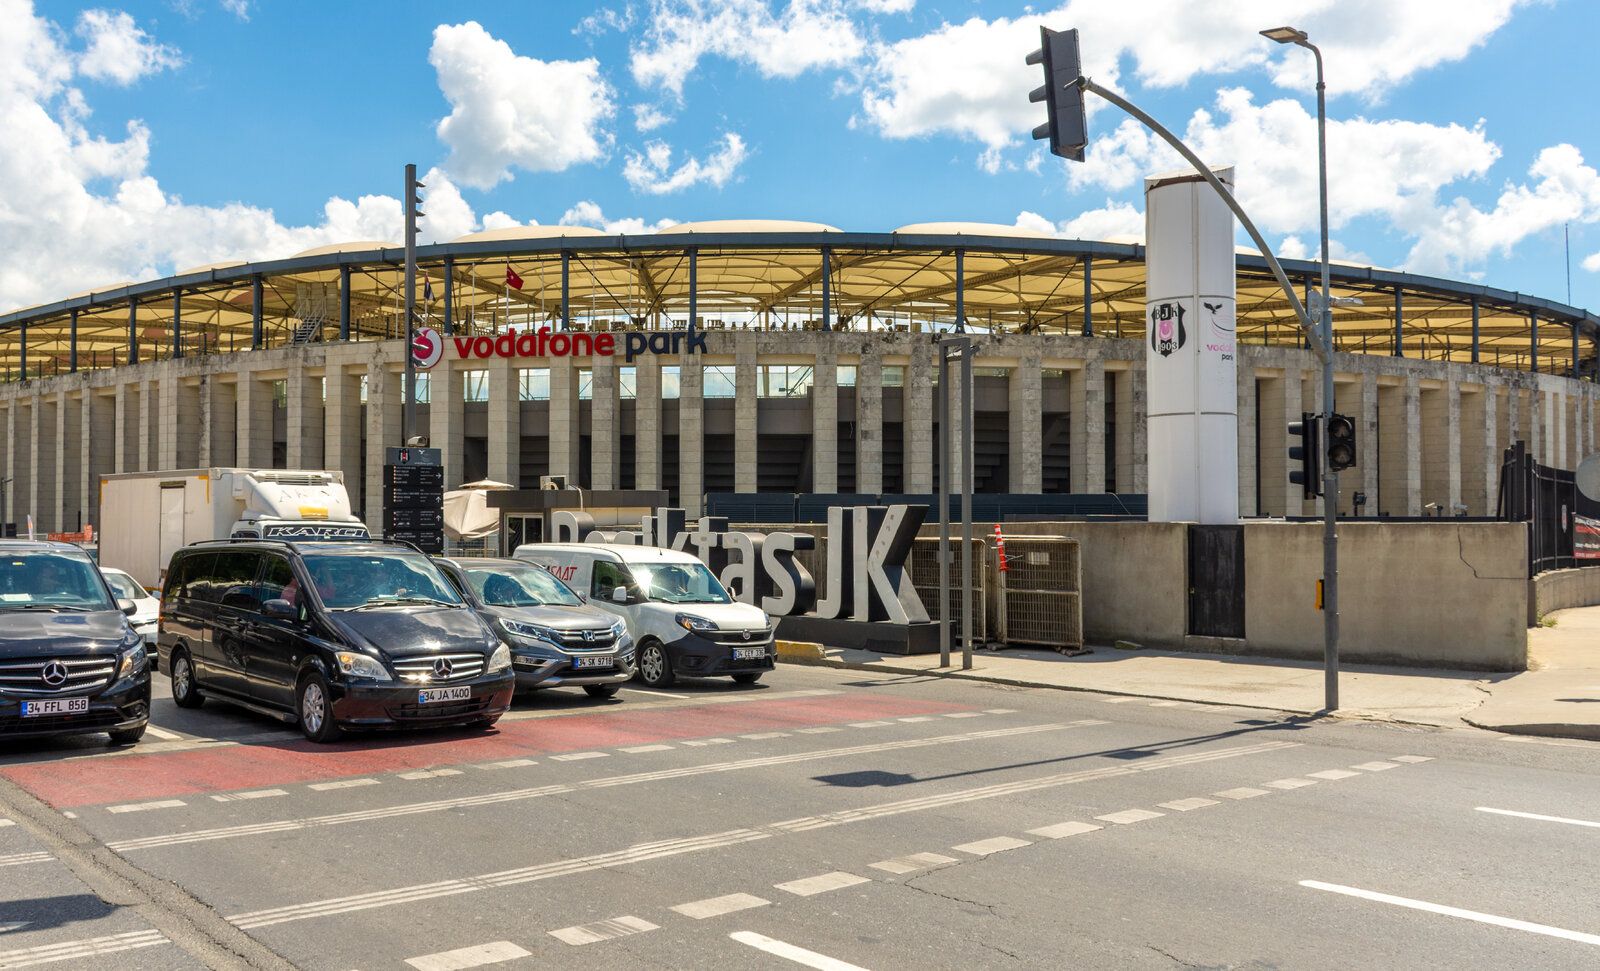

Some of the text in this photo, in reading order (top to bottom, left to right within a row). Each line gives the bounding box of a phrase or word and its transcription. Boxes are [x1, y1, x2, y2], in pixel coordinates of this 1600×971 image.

[1155, 307, 1178, 319] BJK
[453, 325, 708, 363] vodafone park
[1157, 342, 1178, 352] 1903
[578, 658, 586, 666] 34
[588, 658, 596, 666] SK
[425, 688, 470, 700] 34 JA 1400
[28, 700, 87, 713] 34 FFL 858
